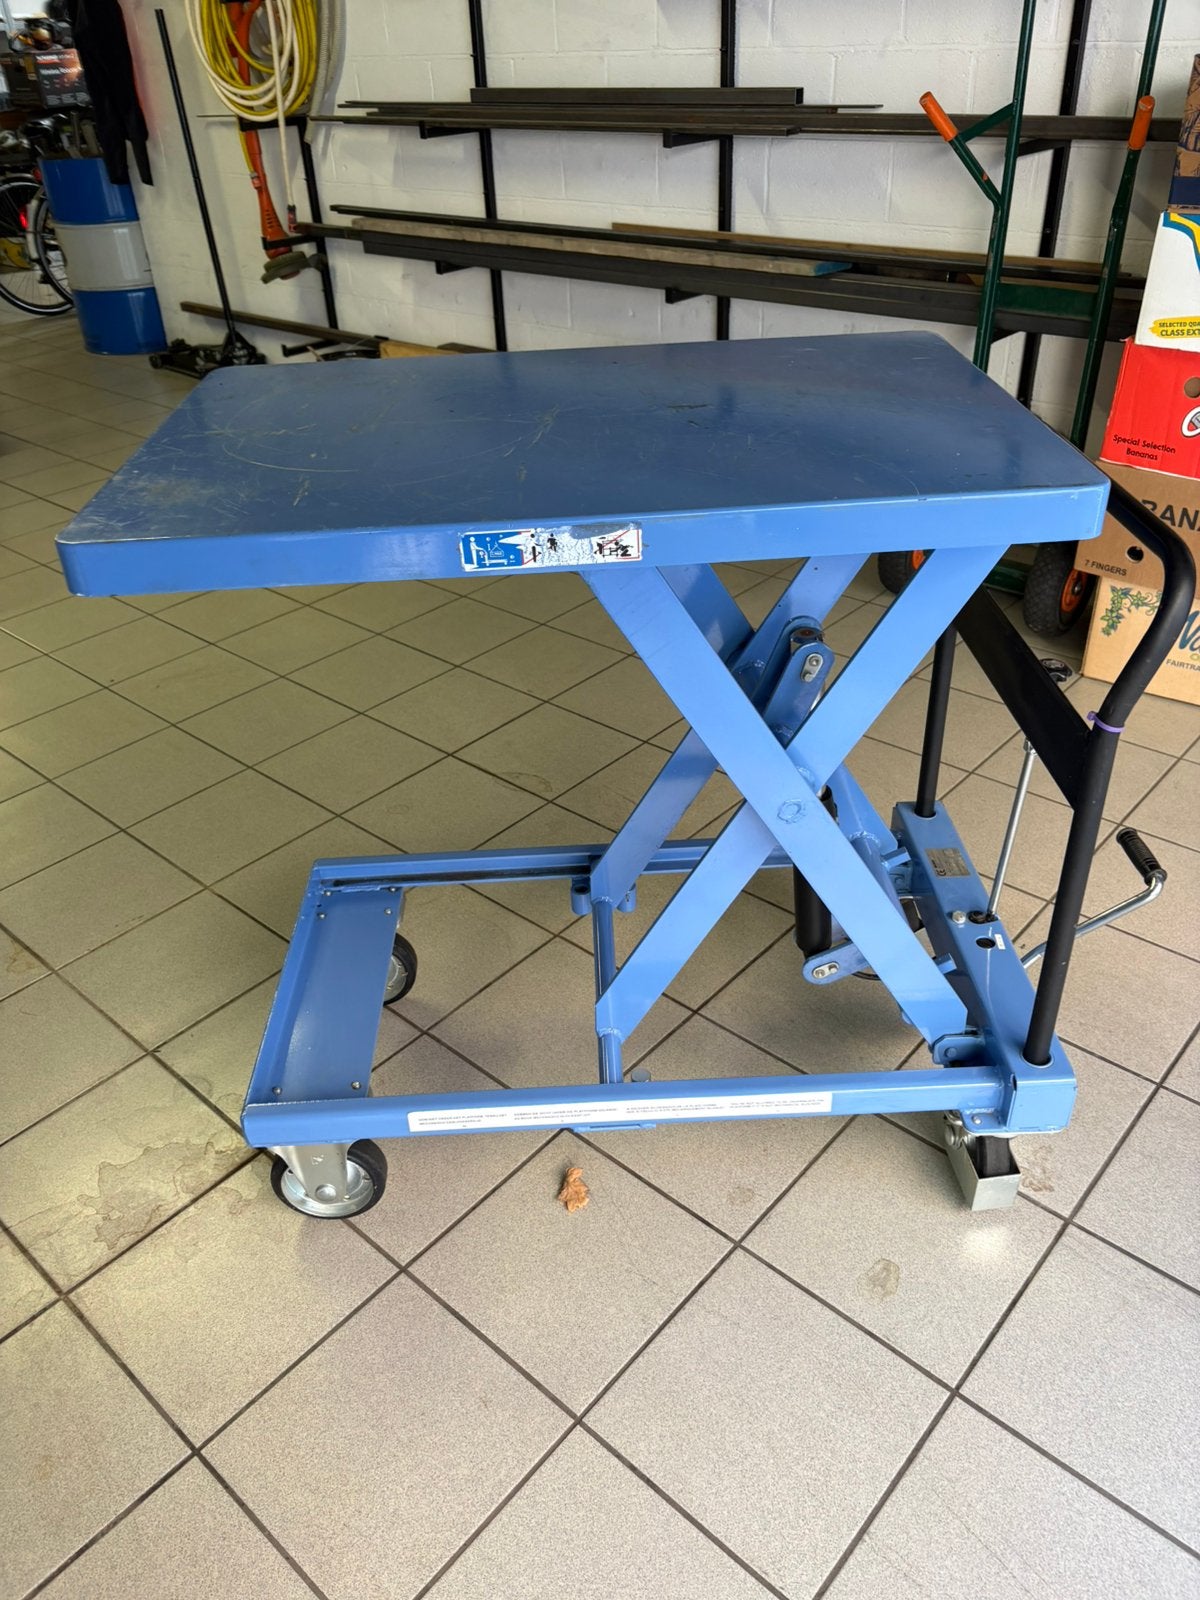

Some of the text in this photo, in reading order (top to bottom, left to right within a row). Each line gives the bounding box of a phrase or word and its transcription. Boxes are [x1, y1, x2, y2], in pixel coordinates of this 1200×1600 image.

[1160, 329, 1185, 337] CLASS
[1113, 434, 1176, 453] Special Selection
[1126, 447, 1158, 461] Bananas
[1091, 561, 1127, 576] FINGERS
